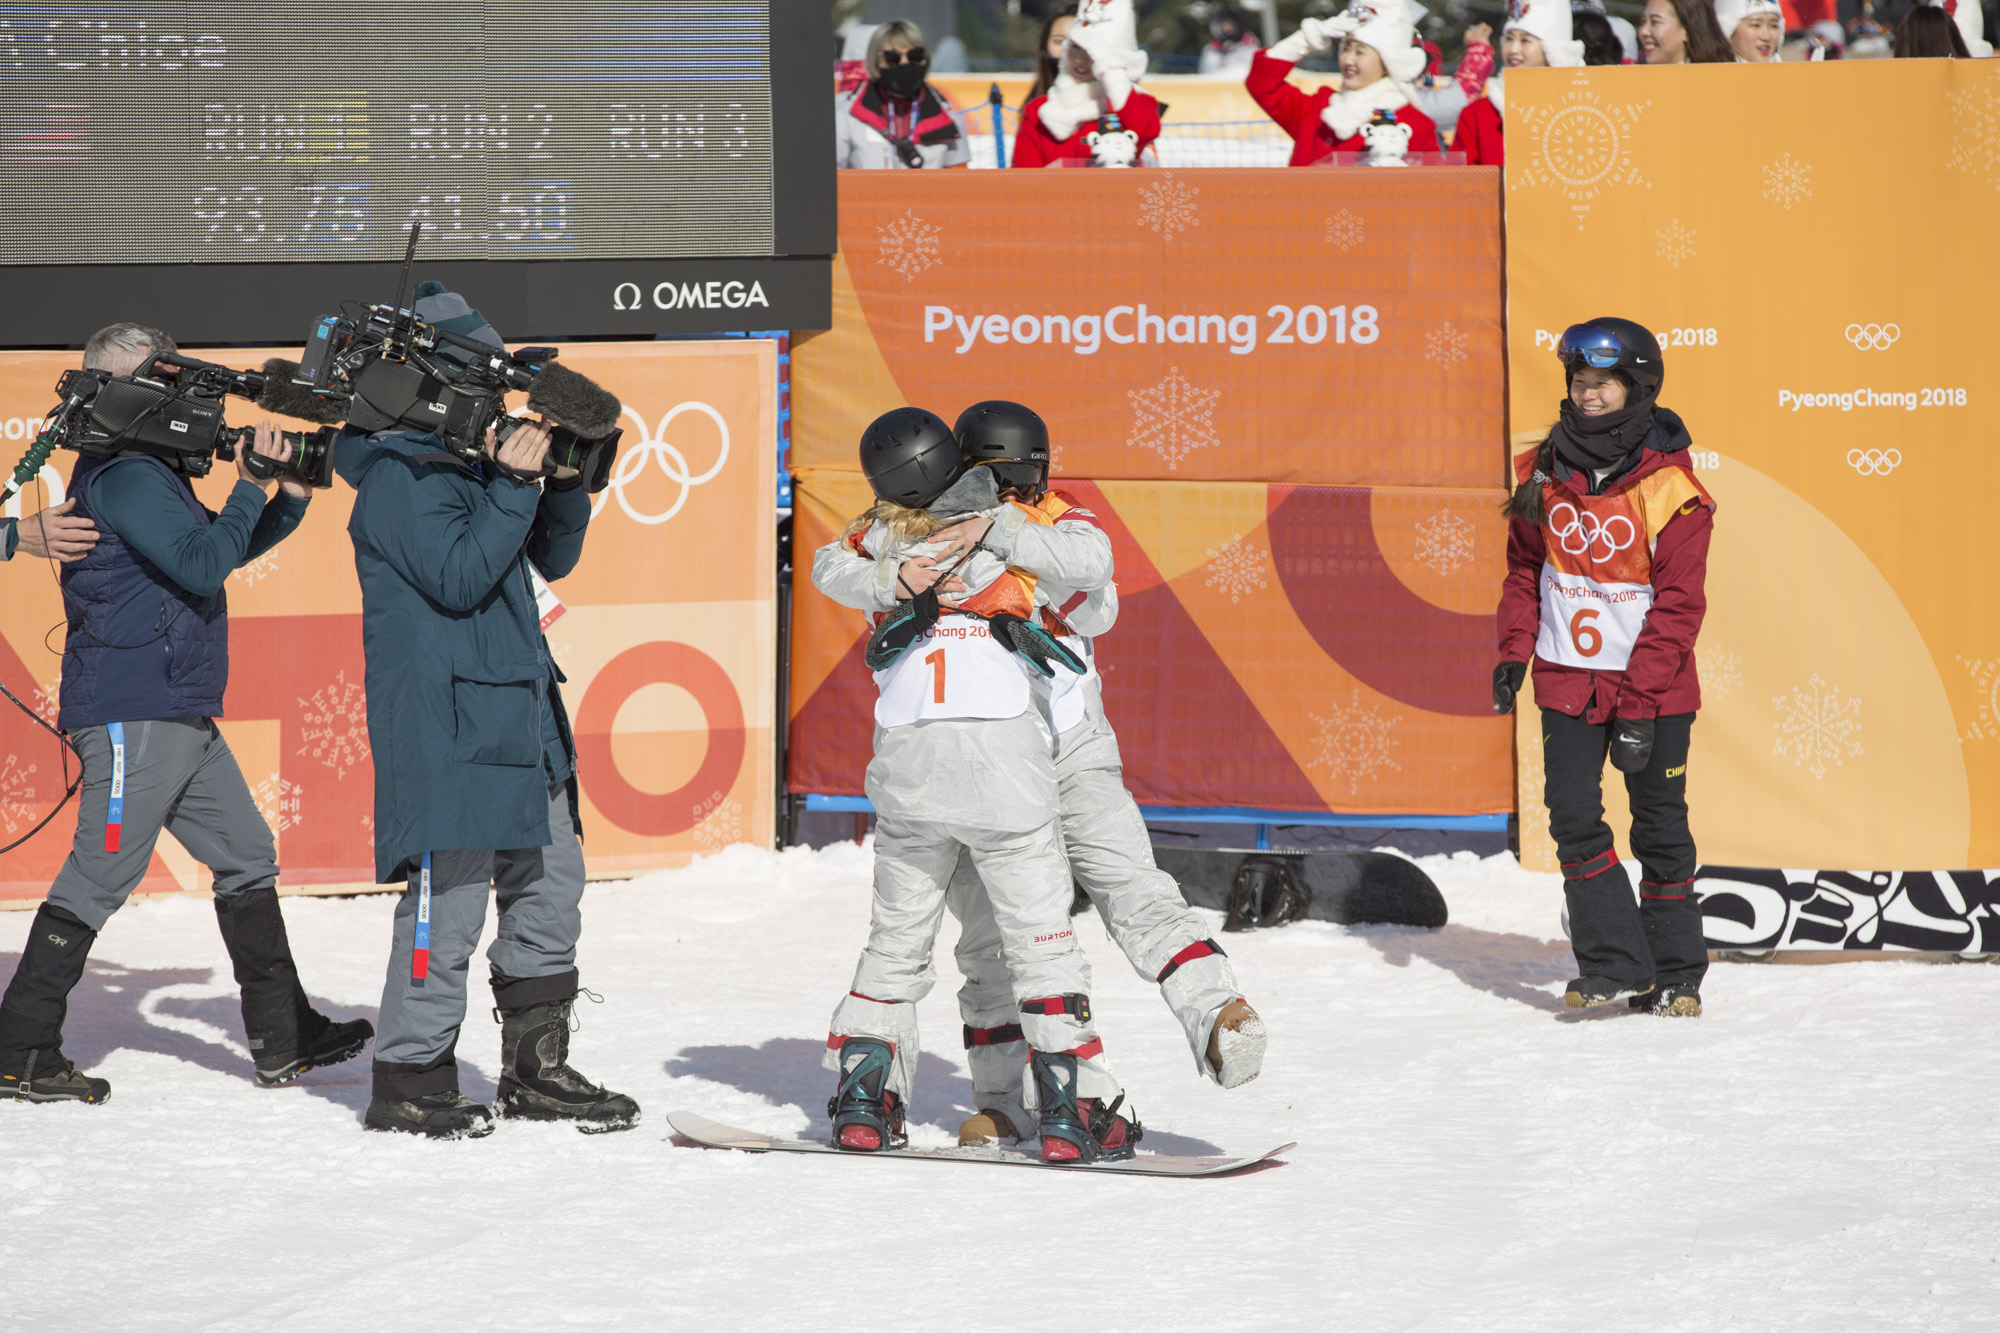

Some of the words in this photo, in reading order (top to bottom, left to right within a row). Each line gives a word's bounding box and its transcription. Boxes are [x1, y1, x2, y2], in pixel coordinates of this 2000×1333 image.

[205, 104, 306, 160] RUN
[410, 104, 508, 159] RUN
[527, 104, 553, 159] 2
[608, 103, 704, 158] RUN
[725, 103, 748, 158] 3
[652, 280, 770, 310] OMEGA
[924, 304, 1257, 354] PyeongChang
[1265, 304, 1380, 345] 2018
[1671, 328, 1718, 346] 2018
[192, 408, 214, 418] SONY
[1778, 388, 1917, 412] PyeongChang
[1920, 387, 1967, 407] 2018
[1689, 451, 1720, 470] 018
[1611, 590, 1638, 603] 2018
[1570, 608, 1603, 658] 6
[925, 648, 946, 704] 1
[1665, 763, 1686, 779] CHIN
[1034, 930, 1072, 943] BURTON
